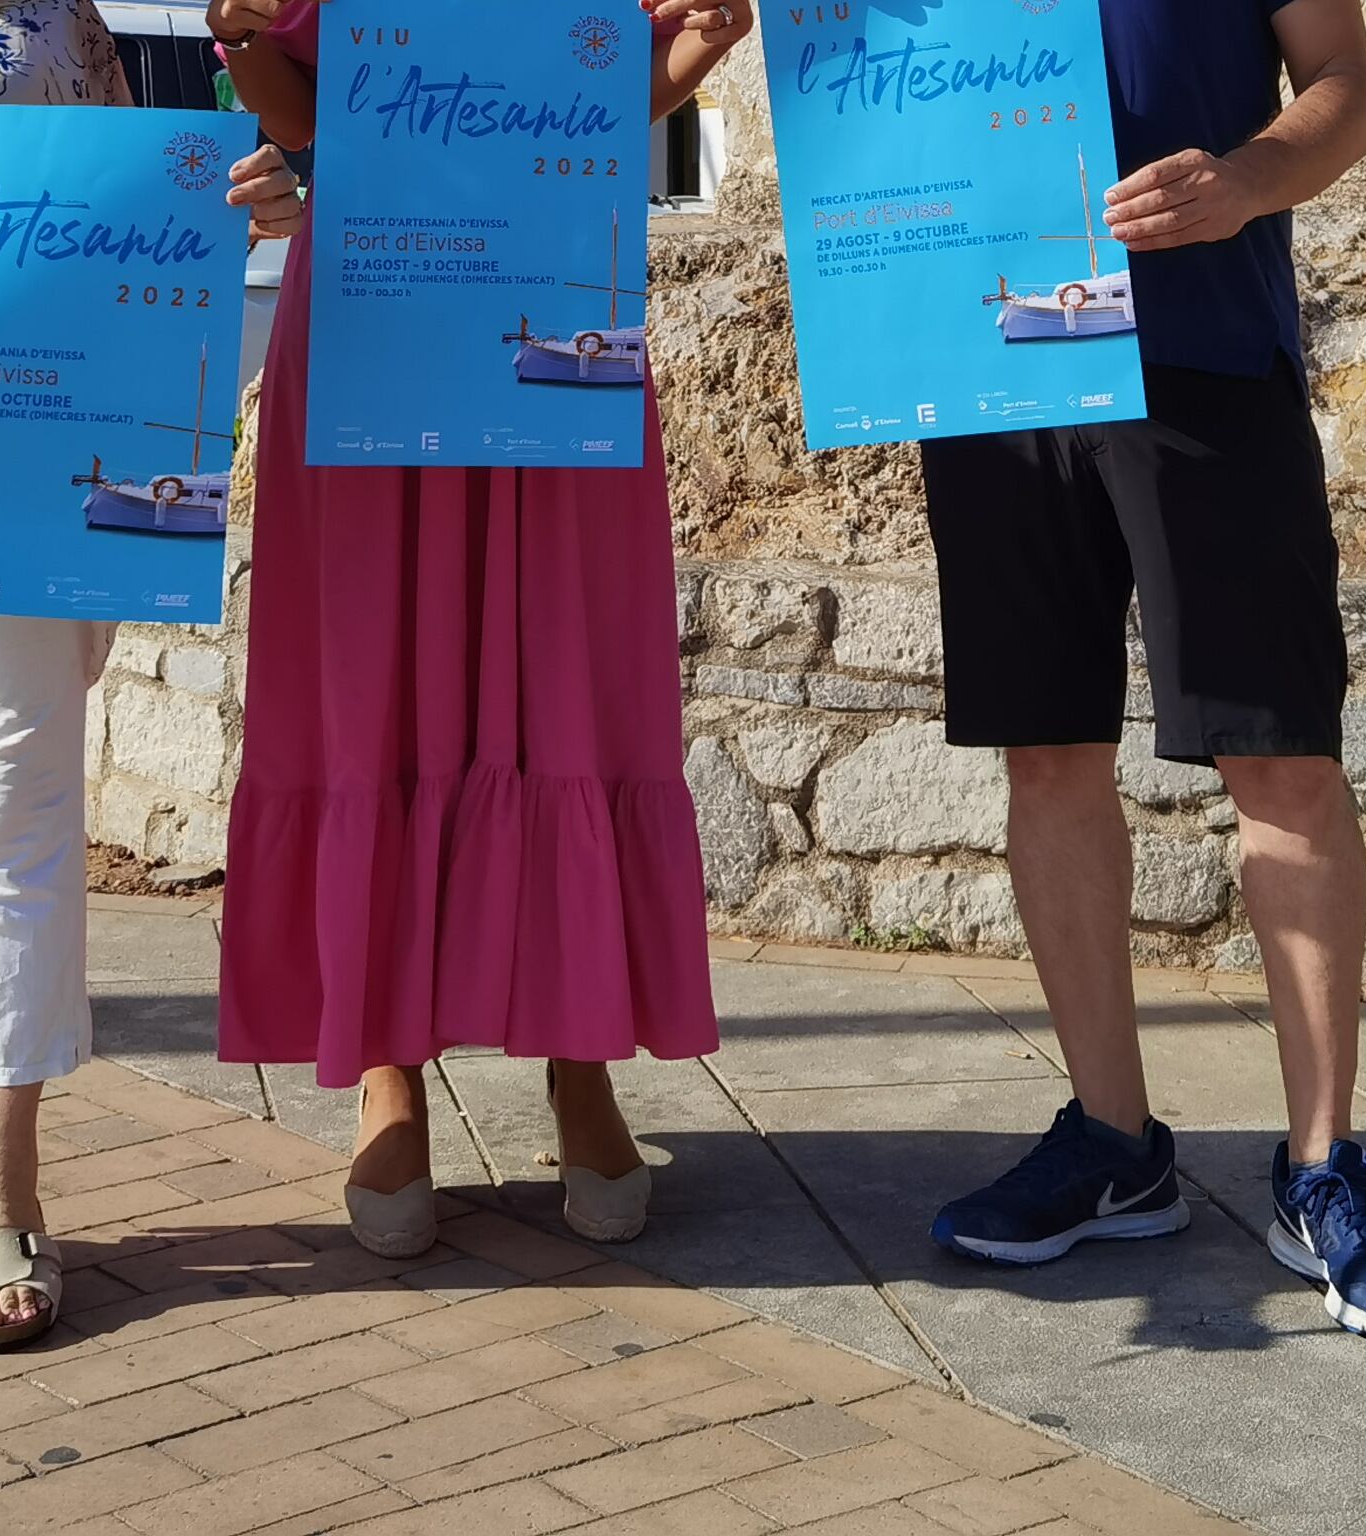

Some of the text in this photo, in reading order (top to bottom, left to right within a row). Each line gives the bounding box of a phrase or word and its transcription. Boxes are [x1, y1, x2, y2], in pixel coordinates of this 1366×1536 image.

[789, 2, 850, 25] VIU
[349, 27, 411, 46] VIU
[797, 37, 1074, 115] l'Artesania
[347, 63, 622, 146] l'Artesania
[989, 103, 1077, 130] 2022
[533, 158, 619, 176] 2022
[811, 179, 973, 207] MERCAT D'ARTESANIA D'EIVISSA
[343, 217, 509, 229] MERCAT D'ARTESANIA D'EIVISSA
[813, 200, 954, 231] Port d'Eivissa
[344, 231, 486, 252] Port d'Eivissa
[816, 238, 832, 251] 29
[836, 233, 880, 249] AGOST
[893, 230, 901, 242] 9
[905, 223, 968, 241] OCTUBRE
[817, 231, 1028, 263] DE DILLUNS A DIUMENGE (DIMECRES TANCAT)
[342, 259, 359, 270] 29
[363, 259, 409, 270] AGOST
[423, 261, 430, 271] 9
[434, 261, 499, 272] OCTUBRE
[880, 263, 886, 271] h
[342, 274, 555, 285] DE DILLUNS A DIUMENGE (DIMECRES TANCAT)
[116, 284, 210, 307] 2022
[406, 289, 411, 297] h
[31, 349, 86, 361] D'EIVISSA
[2, 393, 73, 407] OCTUBRE
[29, 410, 86, 421] (DIMECRES
[89, 413, 134, 425] TANCAT)
